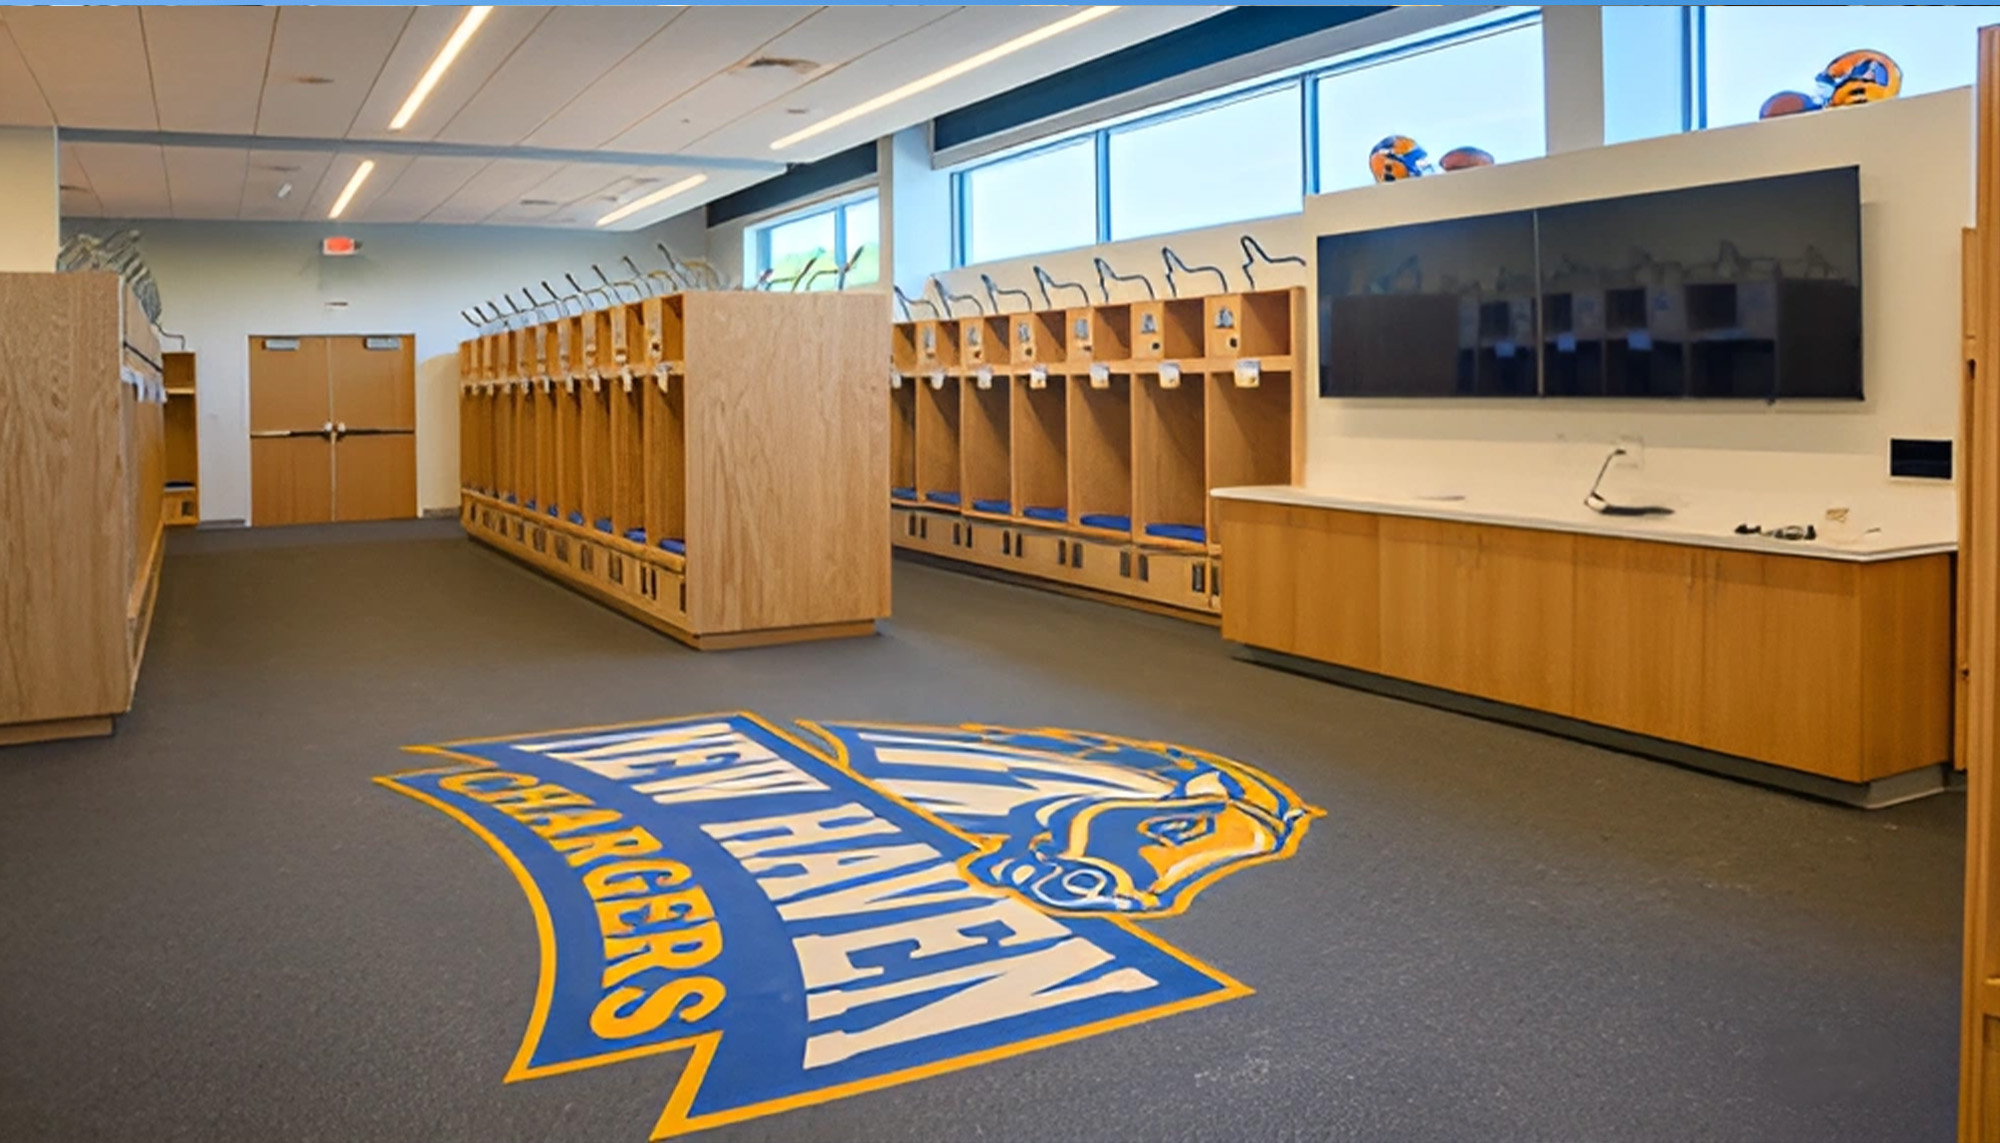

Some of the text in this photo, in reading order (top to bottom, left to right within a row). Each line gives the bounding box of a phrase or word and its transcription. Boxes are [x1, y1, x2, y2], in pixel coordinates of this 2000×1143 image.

[438, 771, 727, 1040] CHARGERS
[509, 722, 1159, 1070] NEW HAVEN
